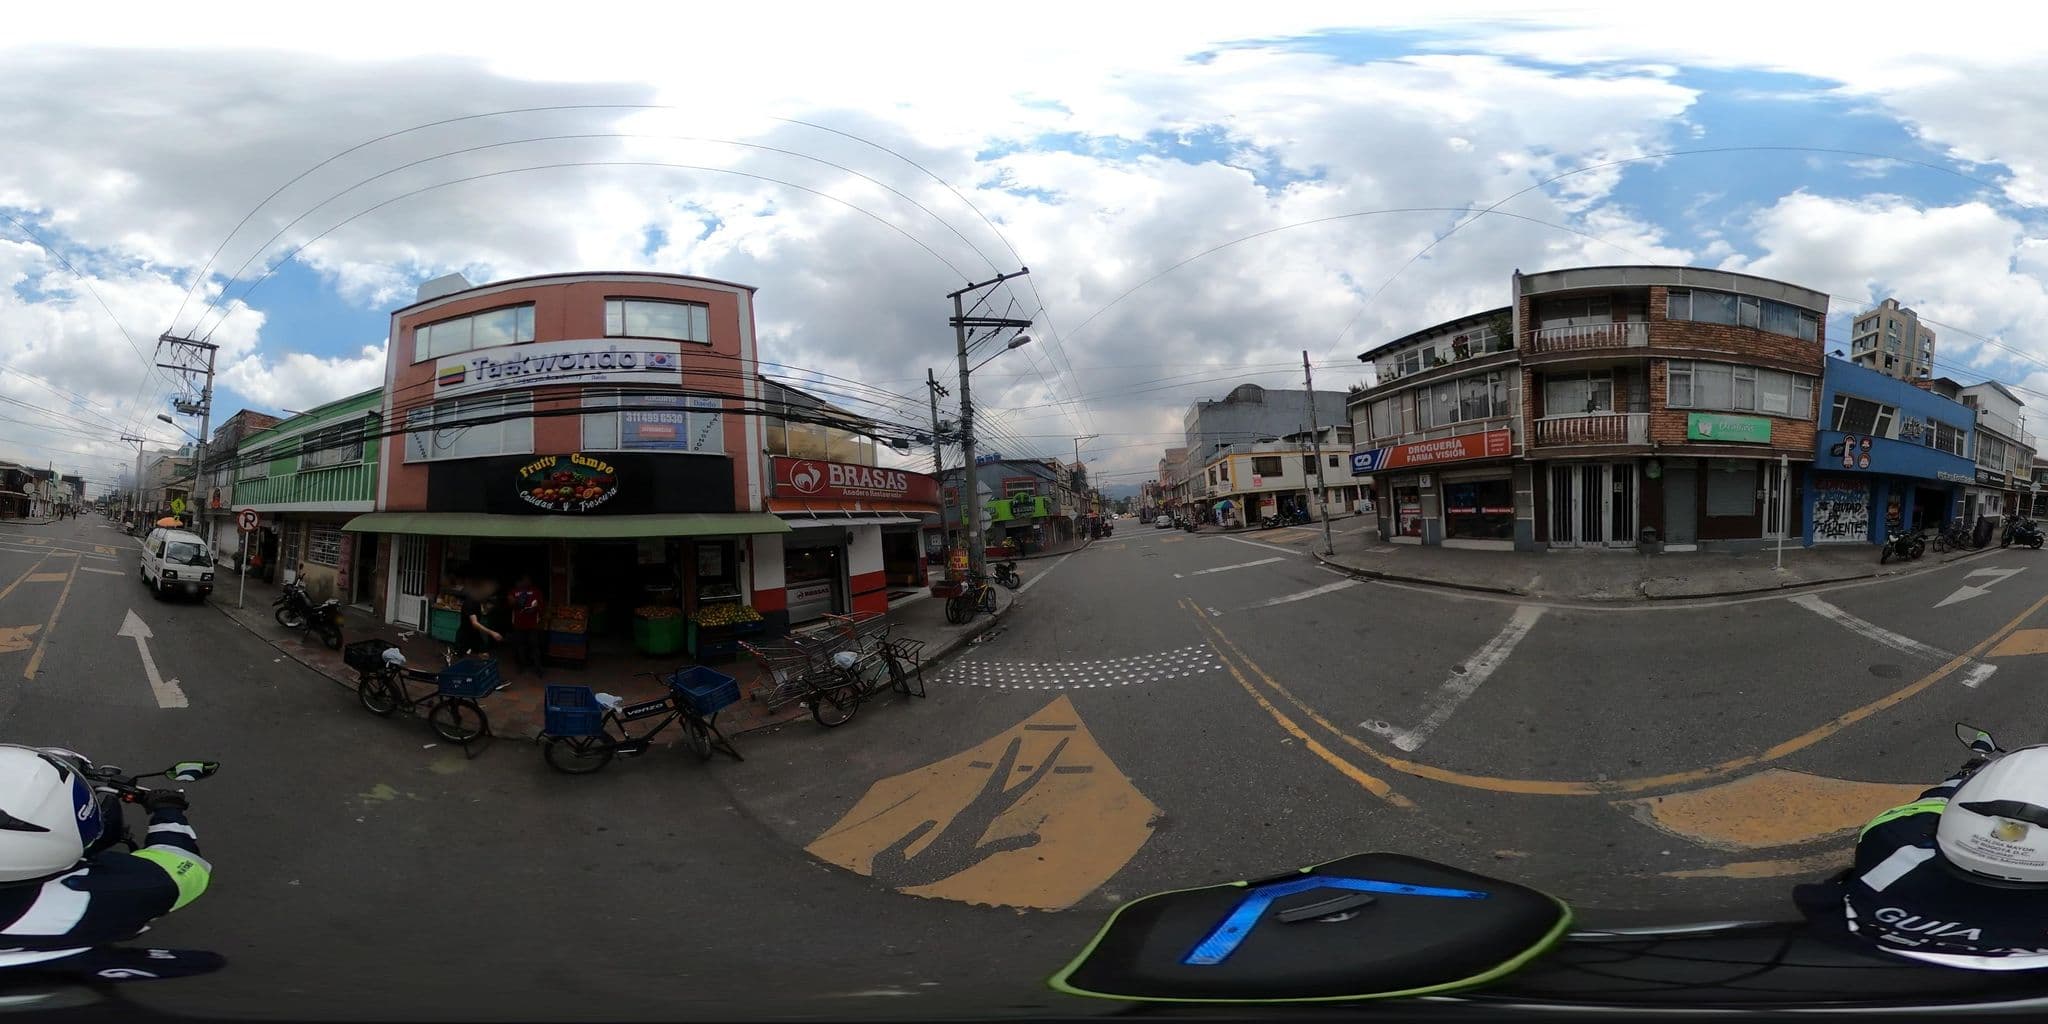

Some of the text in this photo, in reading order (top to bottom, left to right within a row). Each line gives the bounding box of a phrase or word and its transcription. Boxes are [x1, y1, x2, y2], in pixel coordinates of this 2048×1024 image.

[471, 345, 637, 379] Taekwondo
[1406, 448, 1466, 463] FARMA VISIÓN
[1408, 438, 1463, 454] DROGUERÍA
[571, 452, 614, 474] Campo
[828, 463, 908, 491] BRASAS
[519, 490, 554, 510] Calidad
